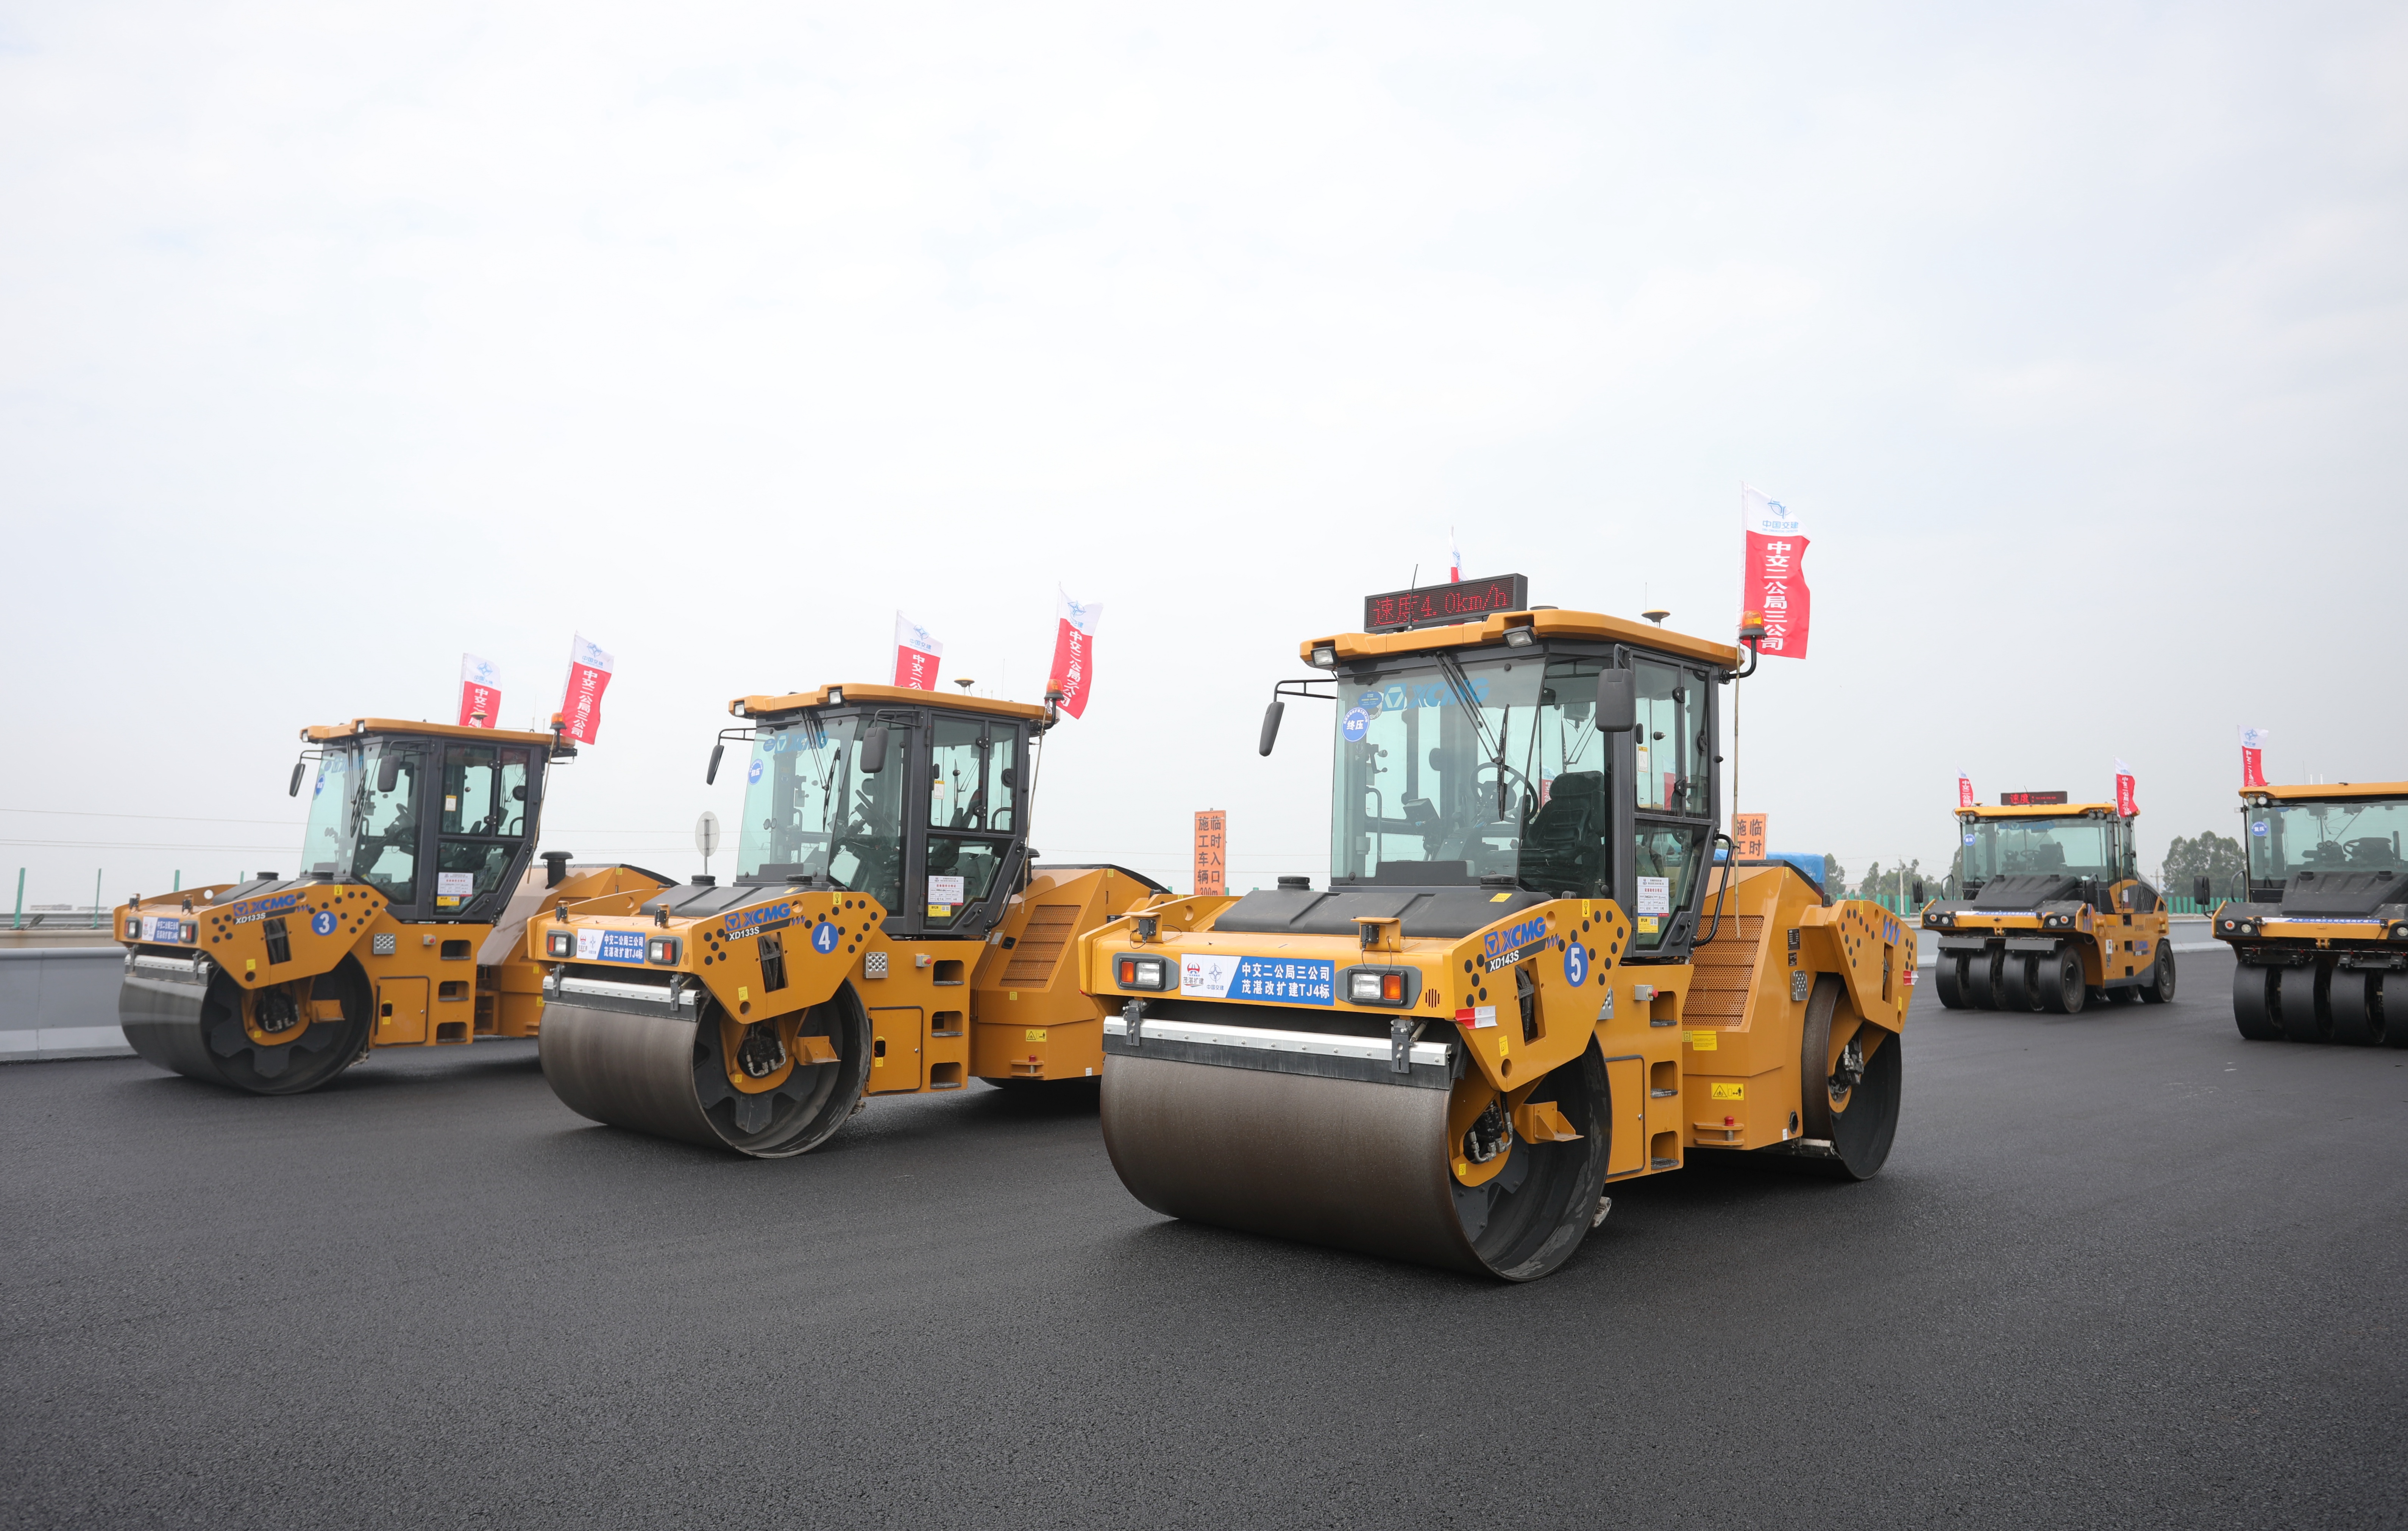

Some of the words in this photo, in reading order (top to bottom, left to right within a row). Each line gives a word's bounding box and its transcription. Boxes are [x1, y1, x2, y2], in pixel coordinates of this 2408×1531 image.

[1762, 520, 1799, 529] 中国交建
[1761, 541, 1791, 651] 中交二公局三公司
[582, 655, 603, 666] 中国交建
[571, 670, 598, 738] 中交二公局三公司
[1347, 719, 1364, 731] 终压
[1749, 819, 1762, 857] 临时
[1198, 816, 1209, 884] 施工车辆
[1210, 815, 1221, 883] 临时入口
[249, 894, 297, 914] XCMG
[235, 912, 266, 925] XD133S
[318, 913, 330, 934] 3
[741, 903, 791, 928] XCMG
[604, 934, 643, 947] 中交二公局三公司
[729, 926, 760, 941] XD133S
[818, 925, 830, 950] 4
[1500, 916, 1546, 953] XCMG
[604, 946, 643, 960] 茂湛改扩建TJ4标
[1490, 950, 1519, 972] XD143S
[1241, 962, 1330, 982] 中交二公局三公司
[1570, 947, 1581, 983] 5
[1183, 976, 1204, 985] 茂湛扩建
[1241, 979, 1330, 999] 茂湛改扩建TJ4标
